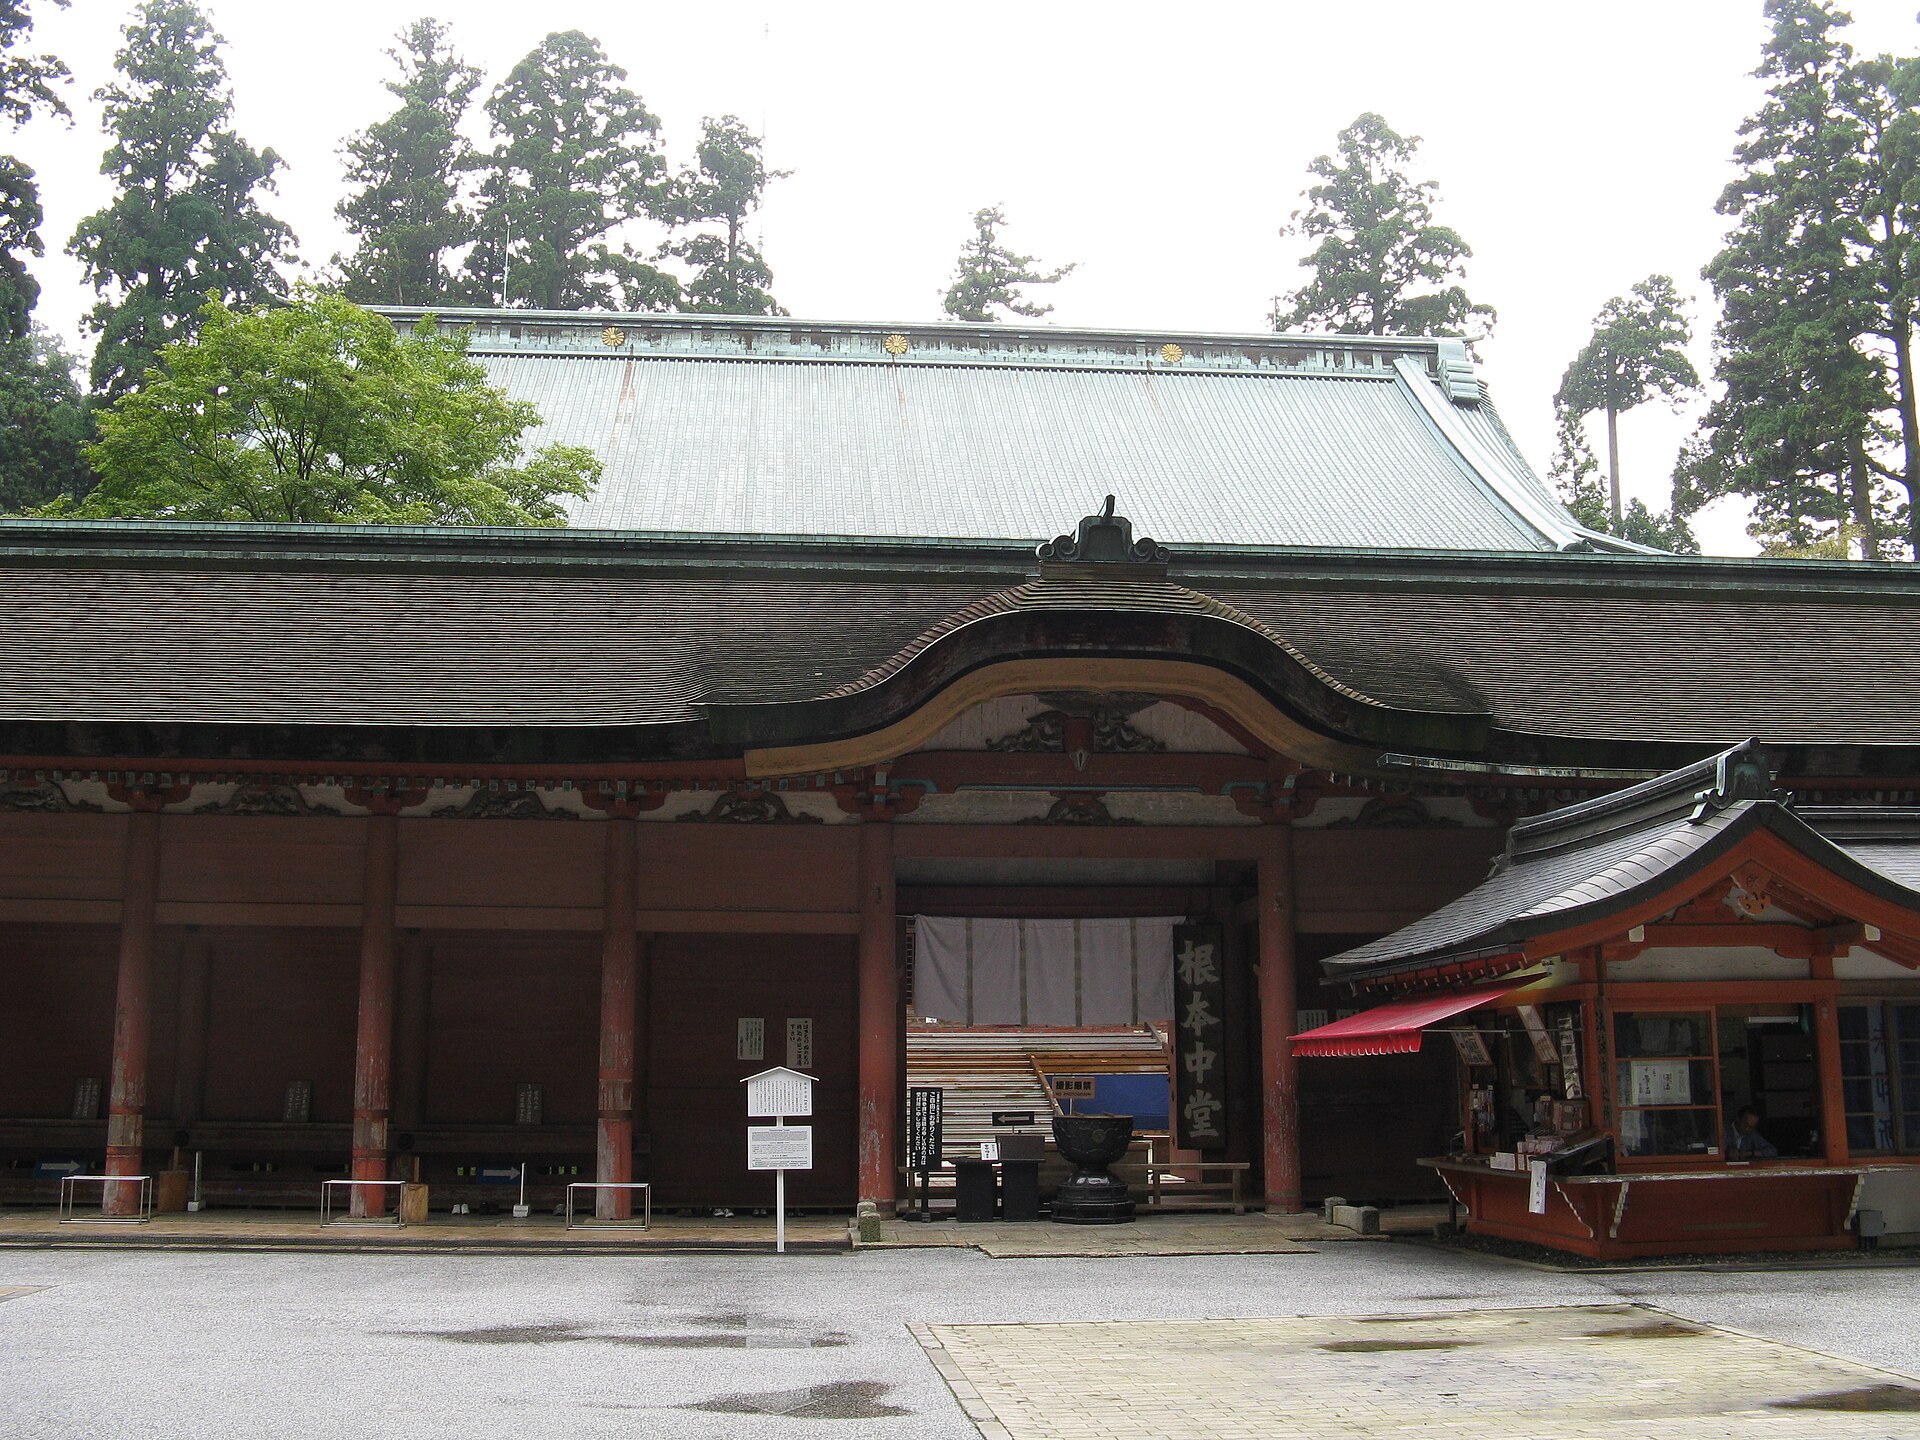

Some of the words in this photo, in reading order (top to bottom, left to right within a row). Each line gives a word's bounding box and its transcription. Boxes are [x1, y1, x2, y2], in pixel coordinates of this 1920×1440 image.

[1056, 1081, 1091, 1090] 撮影厳禁
[1177, 940, 1222, 1138] 根本中堂
